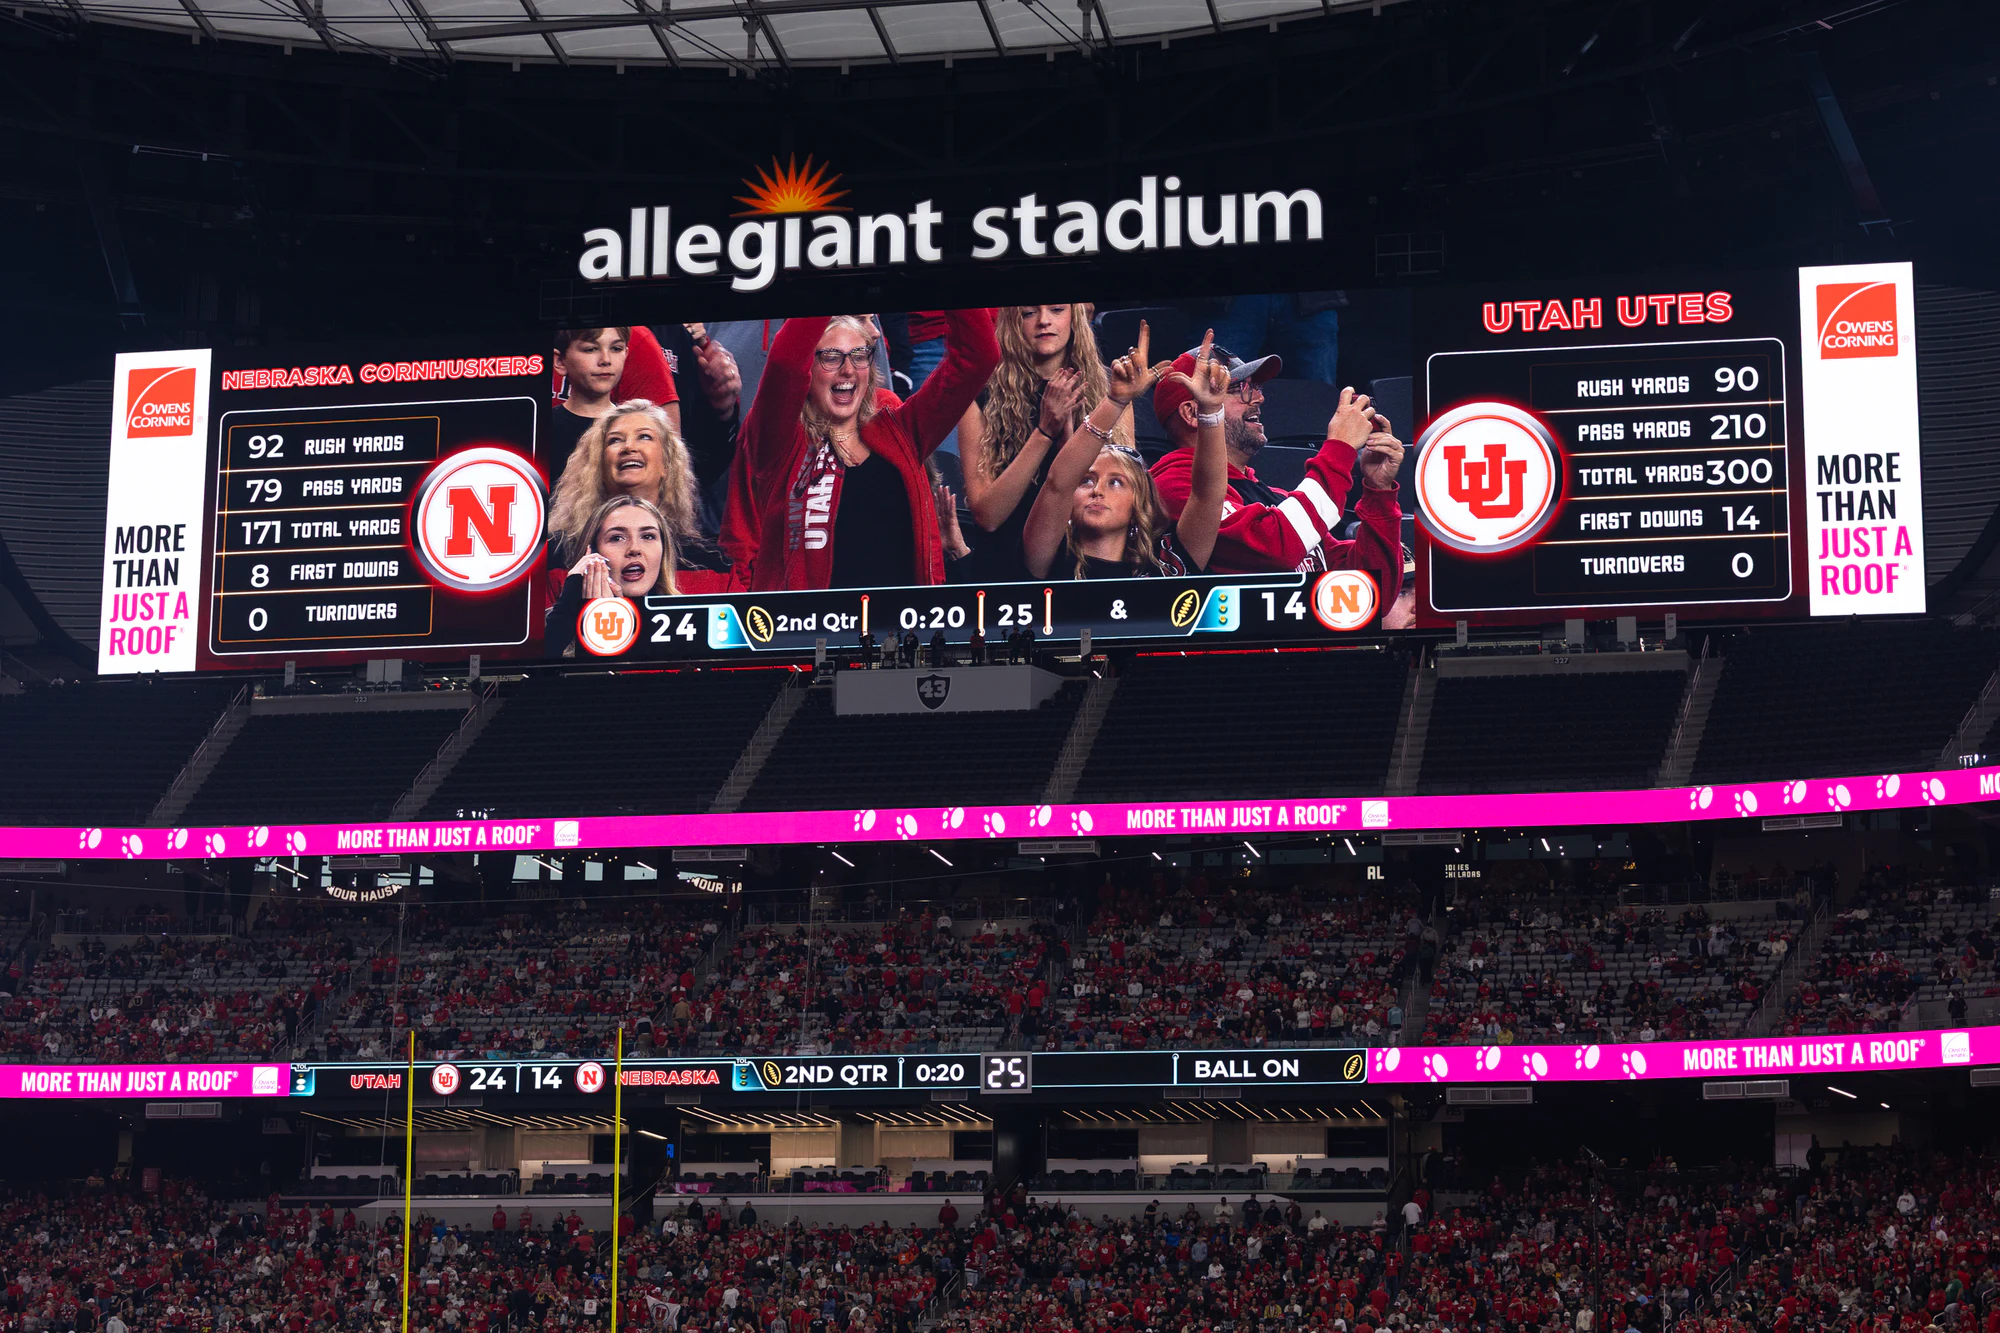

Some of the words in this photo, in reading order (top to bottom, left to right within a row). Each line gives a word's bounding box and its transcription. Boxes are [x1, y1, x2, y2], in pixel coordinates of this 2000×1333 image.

[579, 200, 941, 290] allegiant
[972, 176, 1322, 258] stadium
[1483, 299, 1602, 334] UTAH
[1616, 291, 1733, 327] UTES
[1824, 333, 1894, 348] CORNING
[1836, 321, 1893, 335] OWENS
[222, 364, 354, 390] NEBRASKA
[359, 354, 544, 384] CORNHUSKERS
[1578, 379, 1623, 397] RUSH
[1632, 376, 1689, 394] YARDS
[1715, 366, 1758, 392] 90
[132, 415, 190, 428] CORNING
[143, 403, 190, 416] OWENS
[1578, 424, 1624, 441] PASS
[1633, 421, 1690, 438] YARDS
[1710, 414, 1766, 439] 210
[249, 435, 283, 458] 92
[305, 438, 345, 455] RUSH
[353, 436, 403, 452] YARDS
[1579, 468, 1637, 485] TOTAL
[1646, 465, 1703, 482] YARDS
[1706, 459, 1772, 485] 300
[1818, 452, 1900, 485] MORE
[247, 479, 282, 502] 79
[303, 480, 343, 496] PASS
[351, 477, 402, 494] YARDS
[804, 474, 836, 550] UTAH
[1581, 512, 1632, 530] FIRST
[1640, 510, 1702, 528] DOWNS
[1722, 506, 1760, 530] 14
[1817, 490, 1896, 521] THAN
[115, 524, 186, 554] MORE
[242, 521, 280, 544] 171
[291, 522, 342, 538] TOTAL
[350, 519, 400, 536] YARDS
[1819, 527, 1887, 559] JUST
[1894, 526, 1912, 556] A
[113, 558, 178, 588] THAN
[251, 564, 269, 587] 8
[291, 563, 336, 580] FIRST
[344, 561, 398, 578] DOWNS
[1581, 555, 1684, 575] TURNOVERS
[1732, 553, 1753, 577] 0
[110, 592, 169, 622] JUST
[173, 592, 188, 619] A
[249, 608, 267, 631] 0
[306, 603, 396, 621] TURNOVERS
[651, 613, 696, 642] 24
[777, 614, 816, 631] 2nd
[823, 613, 858, 632] Qtr
[900, 606, 965, 629] 0:20
[998, 604, 1032, 626] 25
[1110, 600, 1127, 619] &
[1262, 592, 1306, 620] 14
[918, 680, 947, 698] 43
[1128, 809, 1175, 828] MORE
[1181, 808, 1225, 827] THAN
[1232, 807, 1272, 826] JUST
[1277, 807, 1288, 825] A
[338, 830, 382, 848] MORE
[387, 828, 428, 847] THAN
[434, 827, 471, 846] JUST
[476, 827, 486, 845] A
[333, 887, 357, 902] OUR
[360, 885, 393, 902] HAUS
[516, 884, 560, 900] Modelo
[698, 879, 724, 894] OUR
[1194, 1060, 1256, 1078] BALL
[1262, 1058, 1299, 1077] ON
[1684, 1048, 1737, 1070] MORE
[1742, 1046, 1793, 1068] THAN
[1800, 1043, 1844, 1066] JUST
[1851, 1042, 1864, 1064] A
[22, 1072, 72, 1092] MORE
[78, 1072, 121, 1091] THAN
[126, 1072, 166, 1091] JUST
[170, 1072, 181, 1090] A
[350, 1074, 401, 1090] UTAH
[469, 1067, 506, 1090] 24
[532, 1067, 562, 1089] 14
[614, 1070, 720, 1086] NEBRASKA
[785, 1066, 833, 1084] 2ND
[840, 1064, 888, 1086] QTR
[916, 1063, 964, 1082] 0:20
[987, 1058, 1025, 1088] 25
